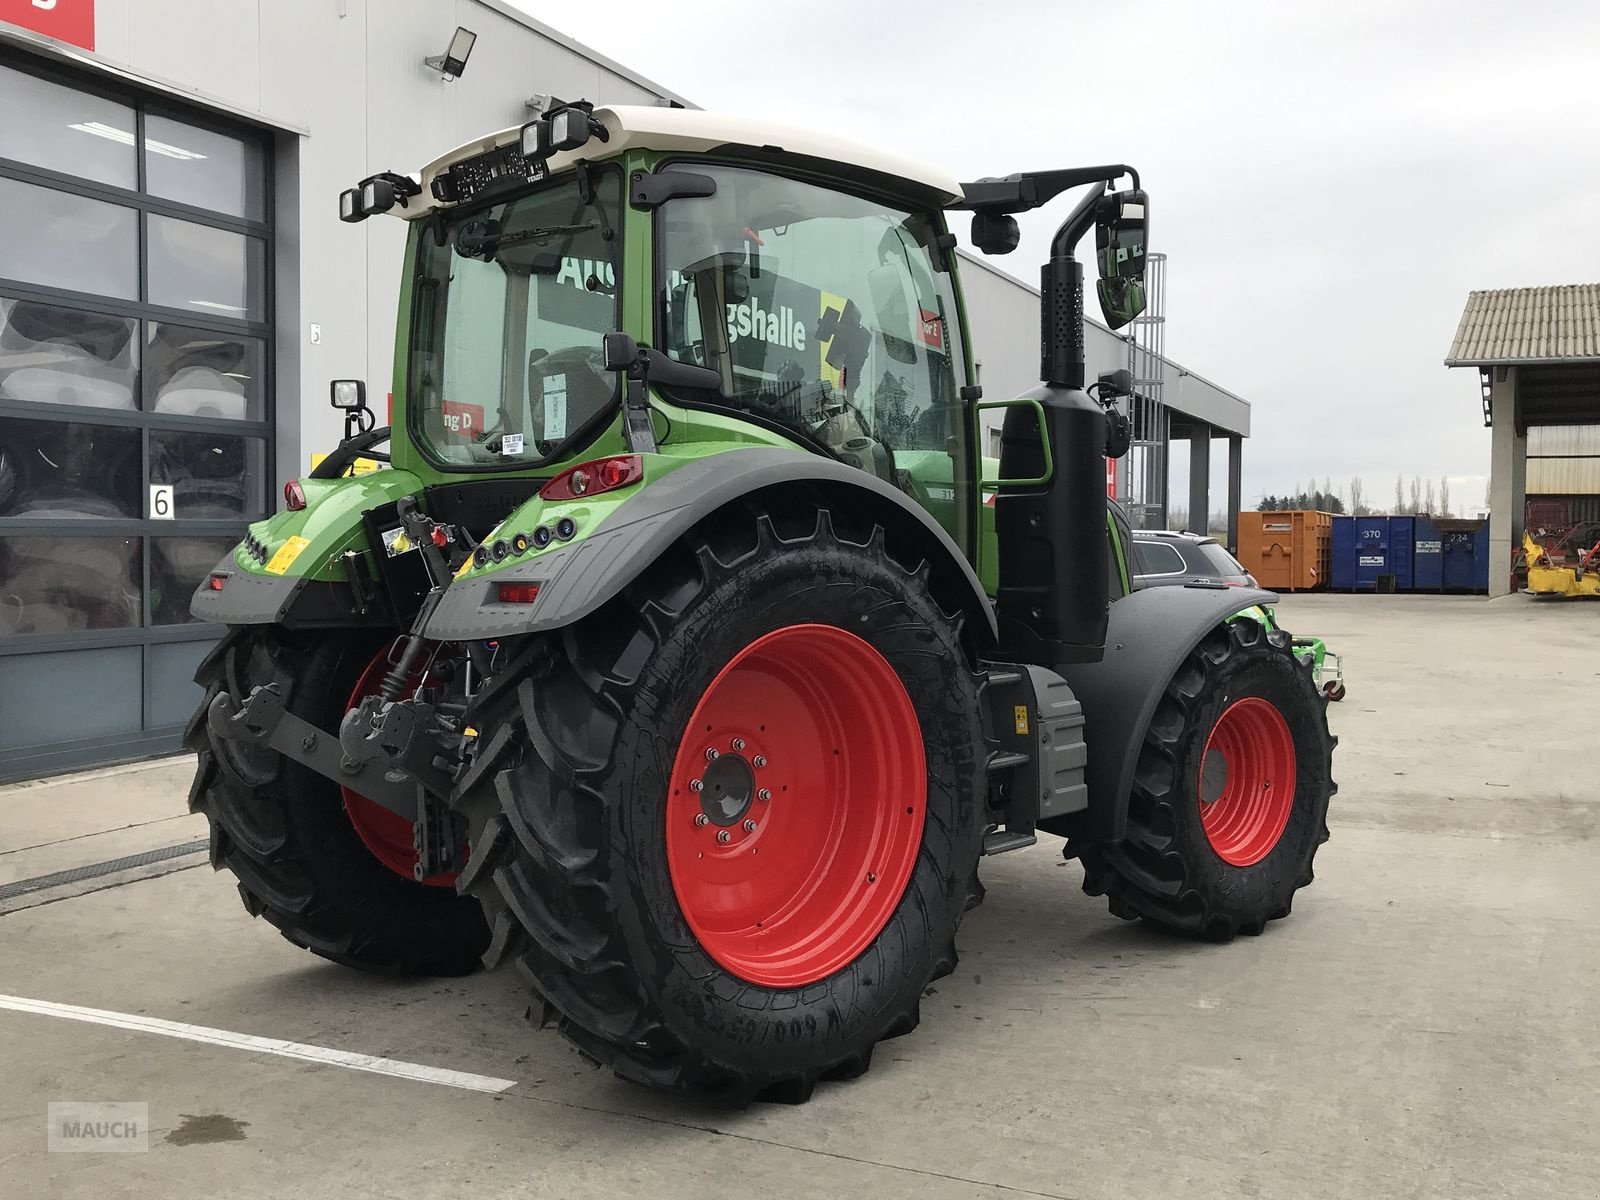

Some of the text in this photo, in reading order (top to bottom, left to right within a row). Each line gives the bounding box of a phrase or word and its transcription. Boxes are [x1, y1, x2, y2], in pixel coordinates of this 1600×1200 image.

[462, 412, 472, 429] D
[155, 489, 168, 516] 6
[1363, 530, 1381, 538] 370
